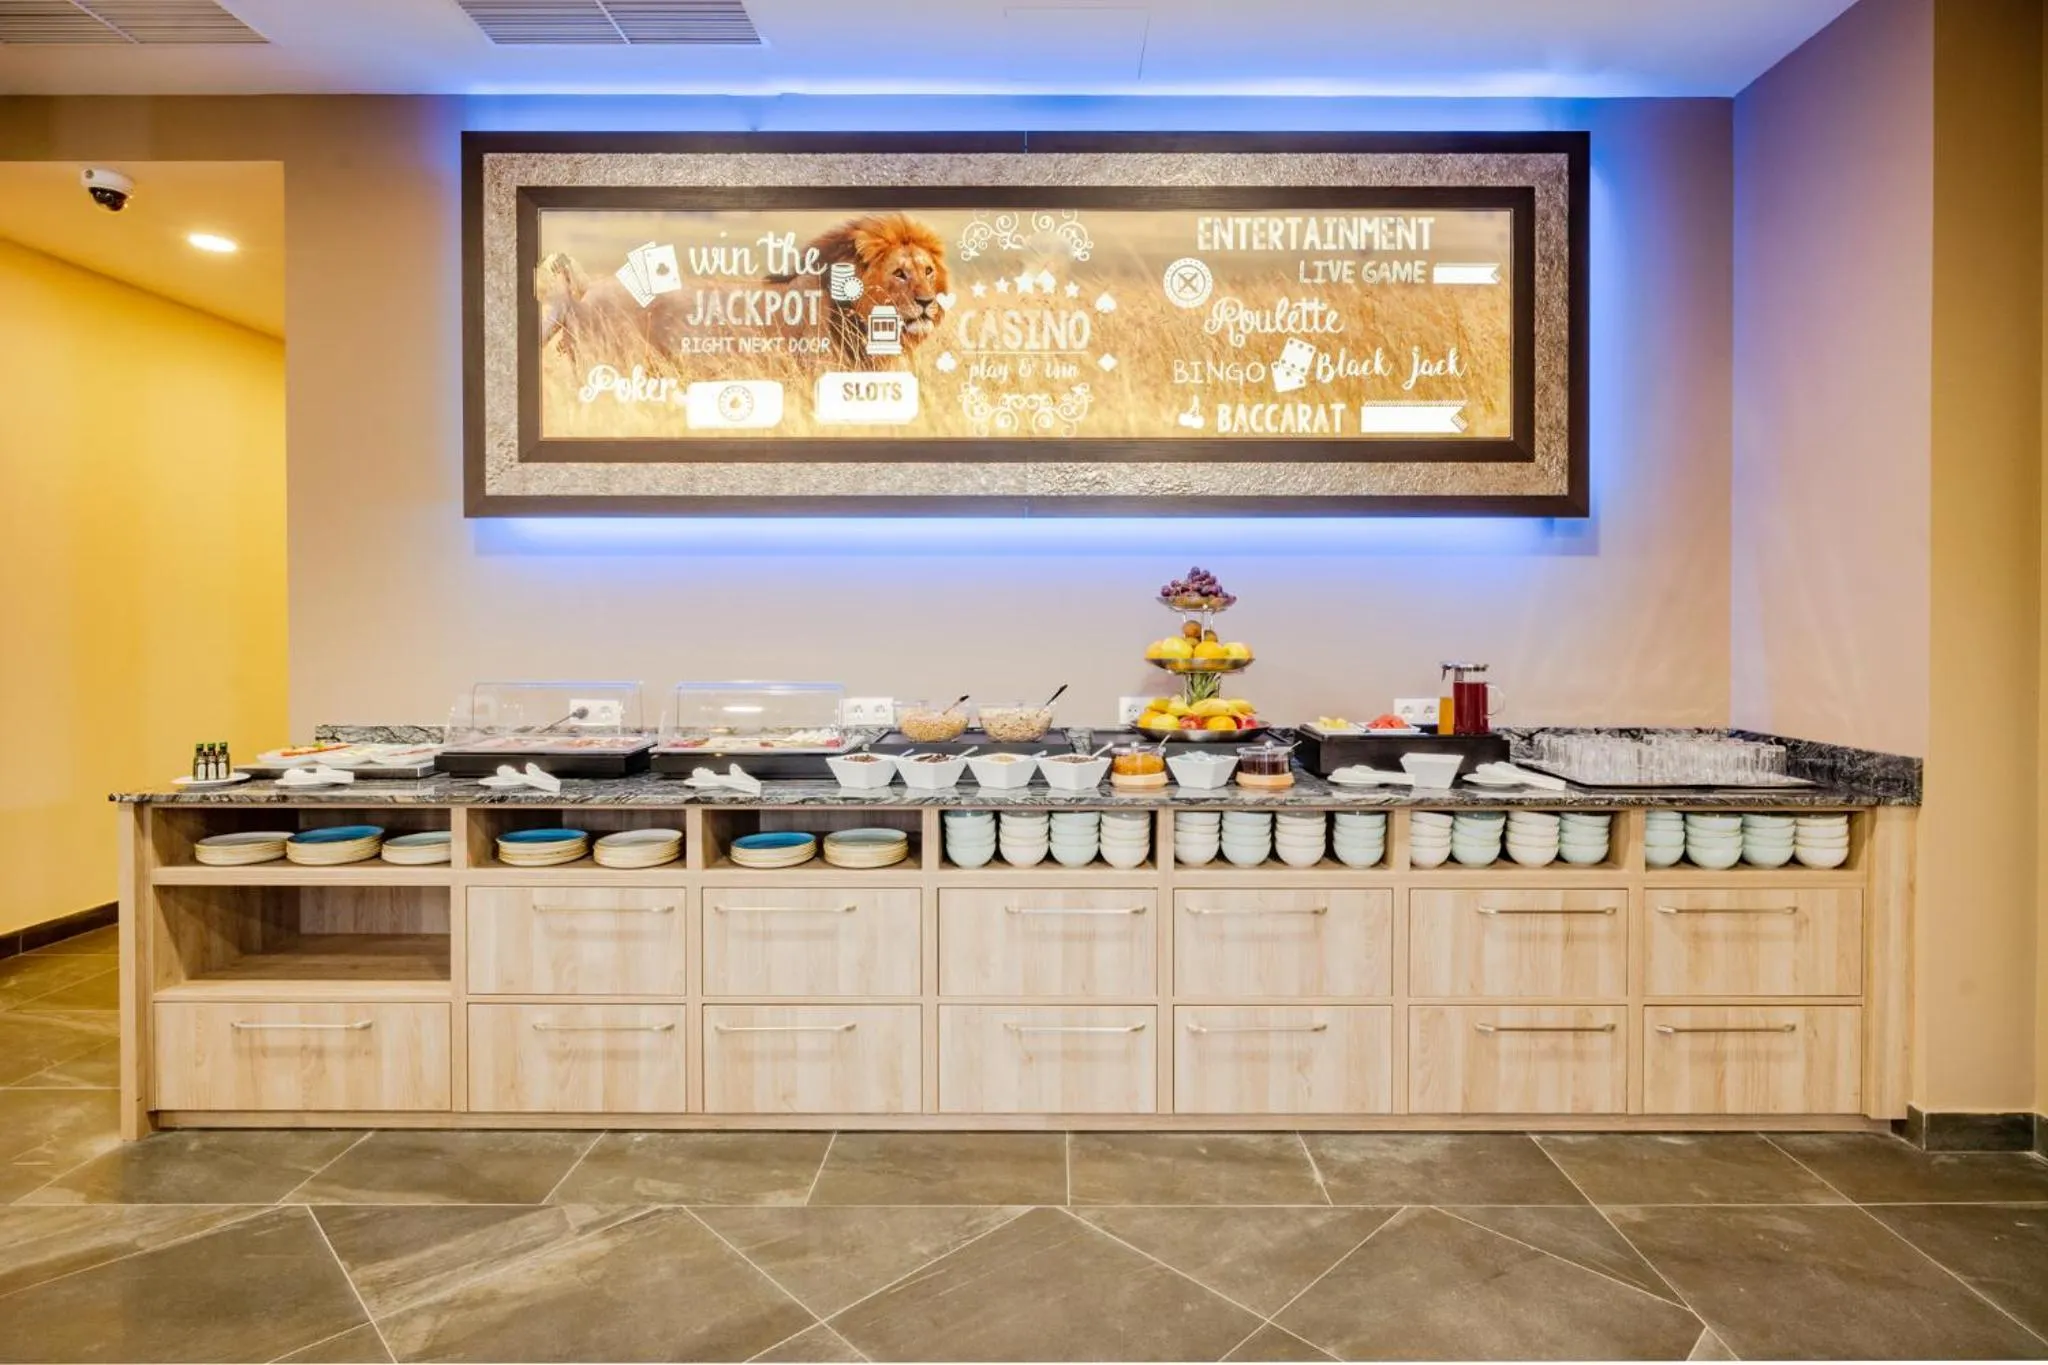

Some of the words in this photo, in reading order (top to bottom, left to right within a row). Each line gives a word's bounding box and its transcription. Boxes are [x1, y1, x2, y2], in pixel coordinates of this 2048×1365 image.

[1197, 216, 1435, 251] ENTERTAINMENT
[688, 230, 756, 276] win
[756, 231, 829, 276] the
[1299, 261, 1355, 284] LIVE
[1361, 260, 1427, 285] GAME
[686, 289, 822, 327] JACKPOT
[1204, 297, 1346, 347] Roulette
[681, 335, 734, 353] RIGHT
[738, 335, 783, 353] NEXT
[787, 335, 830, 353] DOOR
[957, 310, 1090, 351] CASINO
[578, 363, 680, 404] Poker
[1173, 359, 1267, 385] BINGO
[1315, 349, 1393, 384] Black
[842, 380, 902, 402] SLOTS
[1217, 403, 1347, 434] BACCARAT
